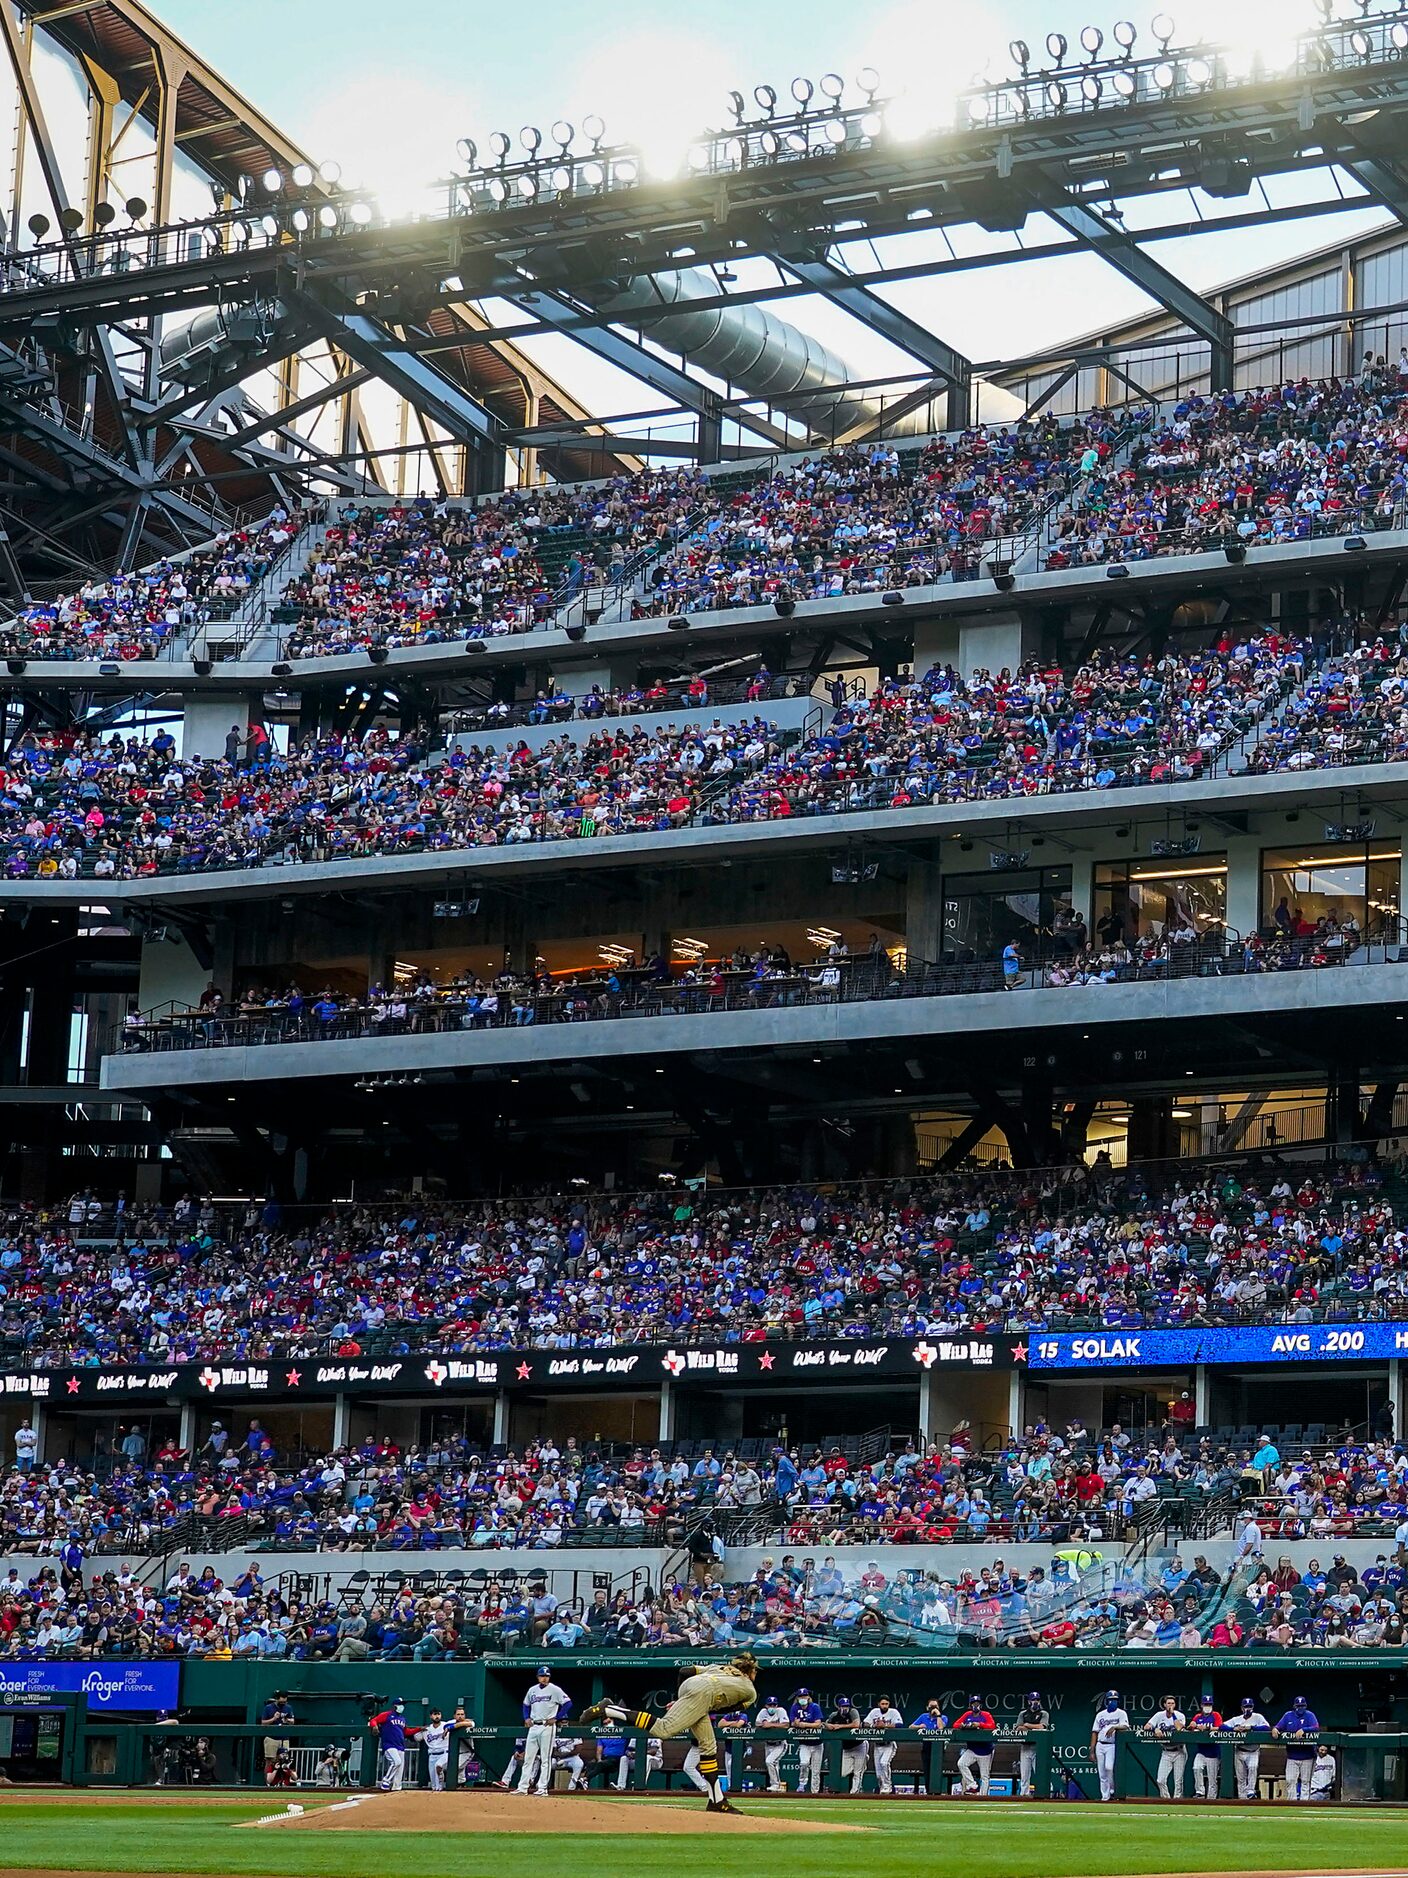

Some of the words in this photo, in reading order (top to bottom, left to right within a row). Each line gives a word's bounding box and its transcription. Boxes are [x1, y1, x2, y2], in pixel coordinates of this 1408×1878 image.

[1023, 1057, 1036, 1066] 122
[1135, 1050, 1146, 1060] 121
[939, 1342, 968, 1360] WILD
[970, 1342, 993, 1360] RAG
[1039, 1343, 1058, 1358] 15
[1072, 1339, 1140, 1358] SOLAK
[1272, 1335, 1310, 1351] AVG
[1320, 1331, 1364, 1350] .200
[549, 1360, 579, 1374] What's
[582, 1359, 603, 1373] Your
[606, 1356, 638, 1373] Wild?
[687, 1351, 714, 1368] WILD
[716, 1351, 738, 1368] RAG
[793, 1351, 825, 1366] What's
[829, 1350, 851, 1365] Your
[854, 1347, 888, 1364] Wild?
[222, 1368, 247, 1384] WILD
[248, 1367, 268, 1384] RAG
[317, 1367, 346, 1381] What's
[349, 1367, 368, 1381] Your
[371, 1364, 402, 1380] Wild?
[449, 1361, 473, 1378] WILD
[476, 1360, 497, 1377] RAG
[5, 1376, 29, 1392] WILD
[30, 1375, 49, 1391] RAG
[97, 1376, 124, 1390] What's
[127, 1375, 146, 1389] Your
[149, 1372, 178, 1388] Wild?
[82, 1671, 124, 1701] Kroger
